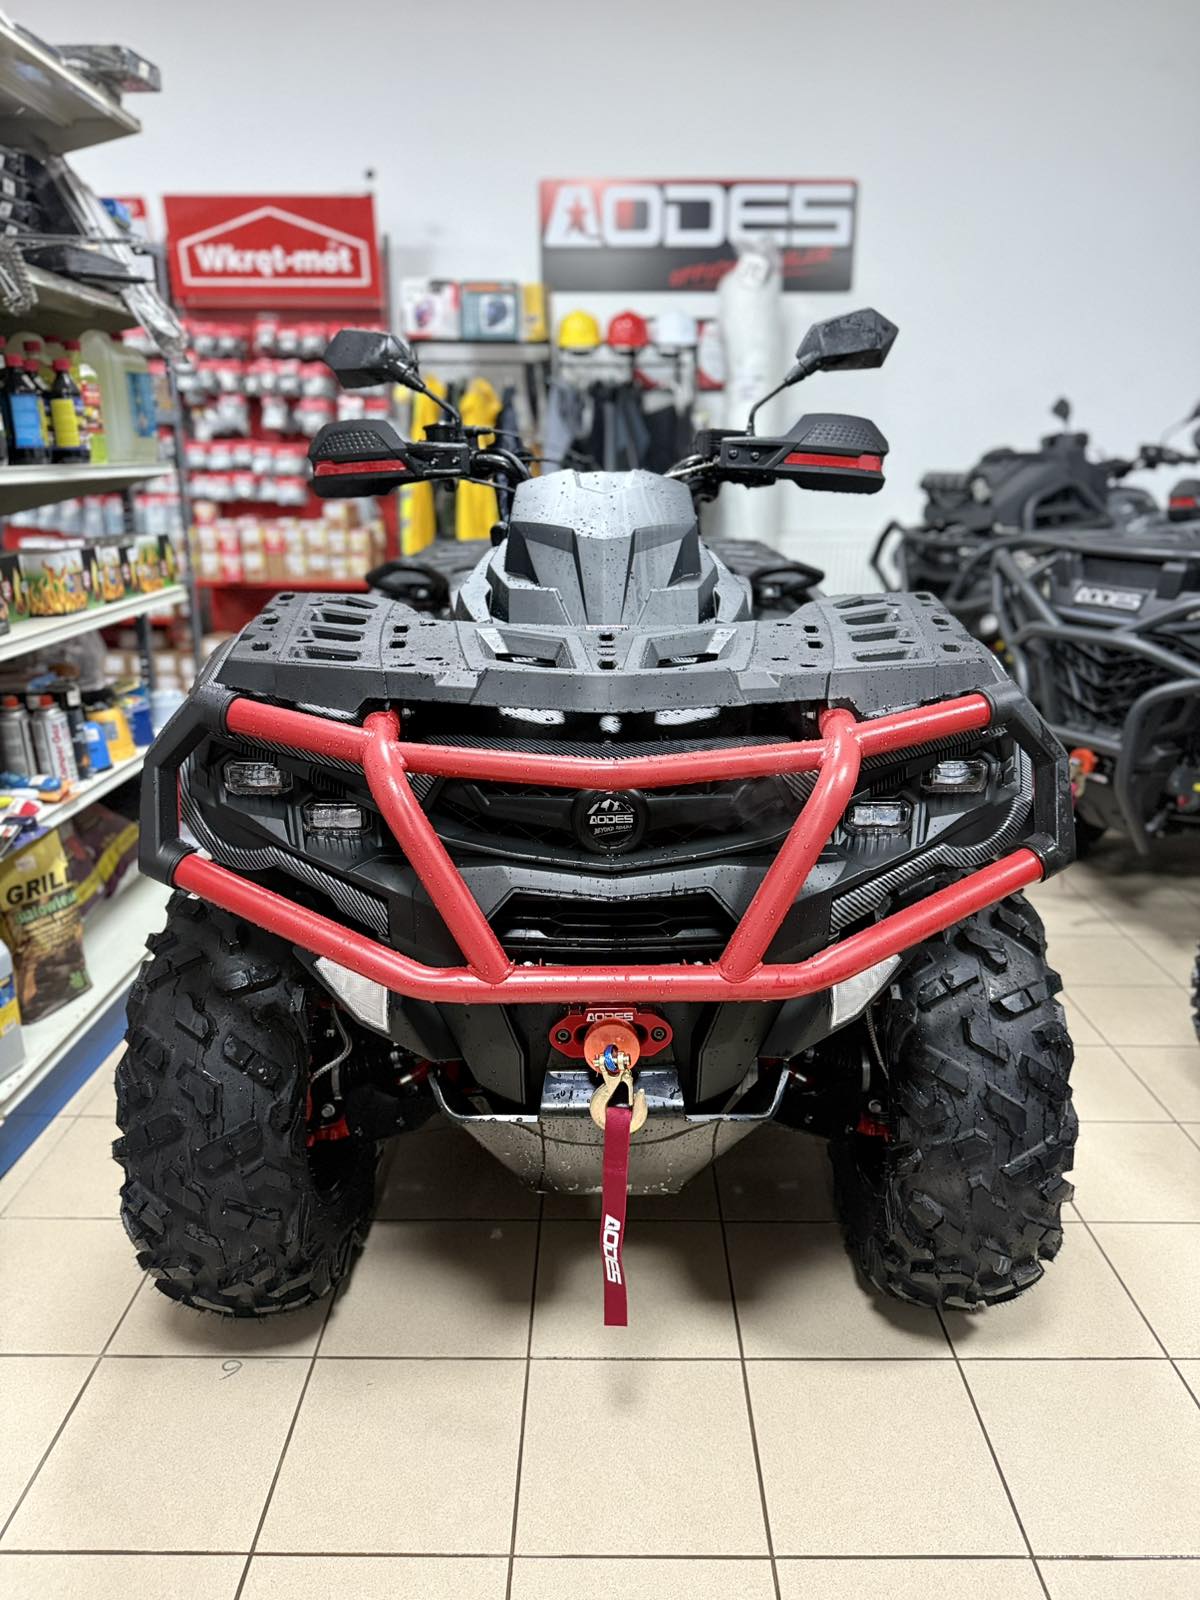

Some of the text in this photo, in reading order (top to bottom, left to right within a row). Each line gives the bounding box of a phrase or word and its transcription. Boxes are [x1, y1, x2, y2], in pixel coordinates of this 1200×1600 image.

[543, 184, 853, 248] AODES
[1075, 587, 1142, 611] AODES
[590, 815, 634, 825] AODES
[603, 1214, 622, 1285] AODES
